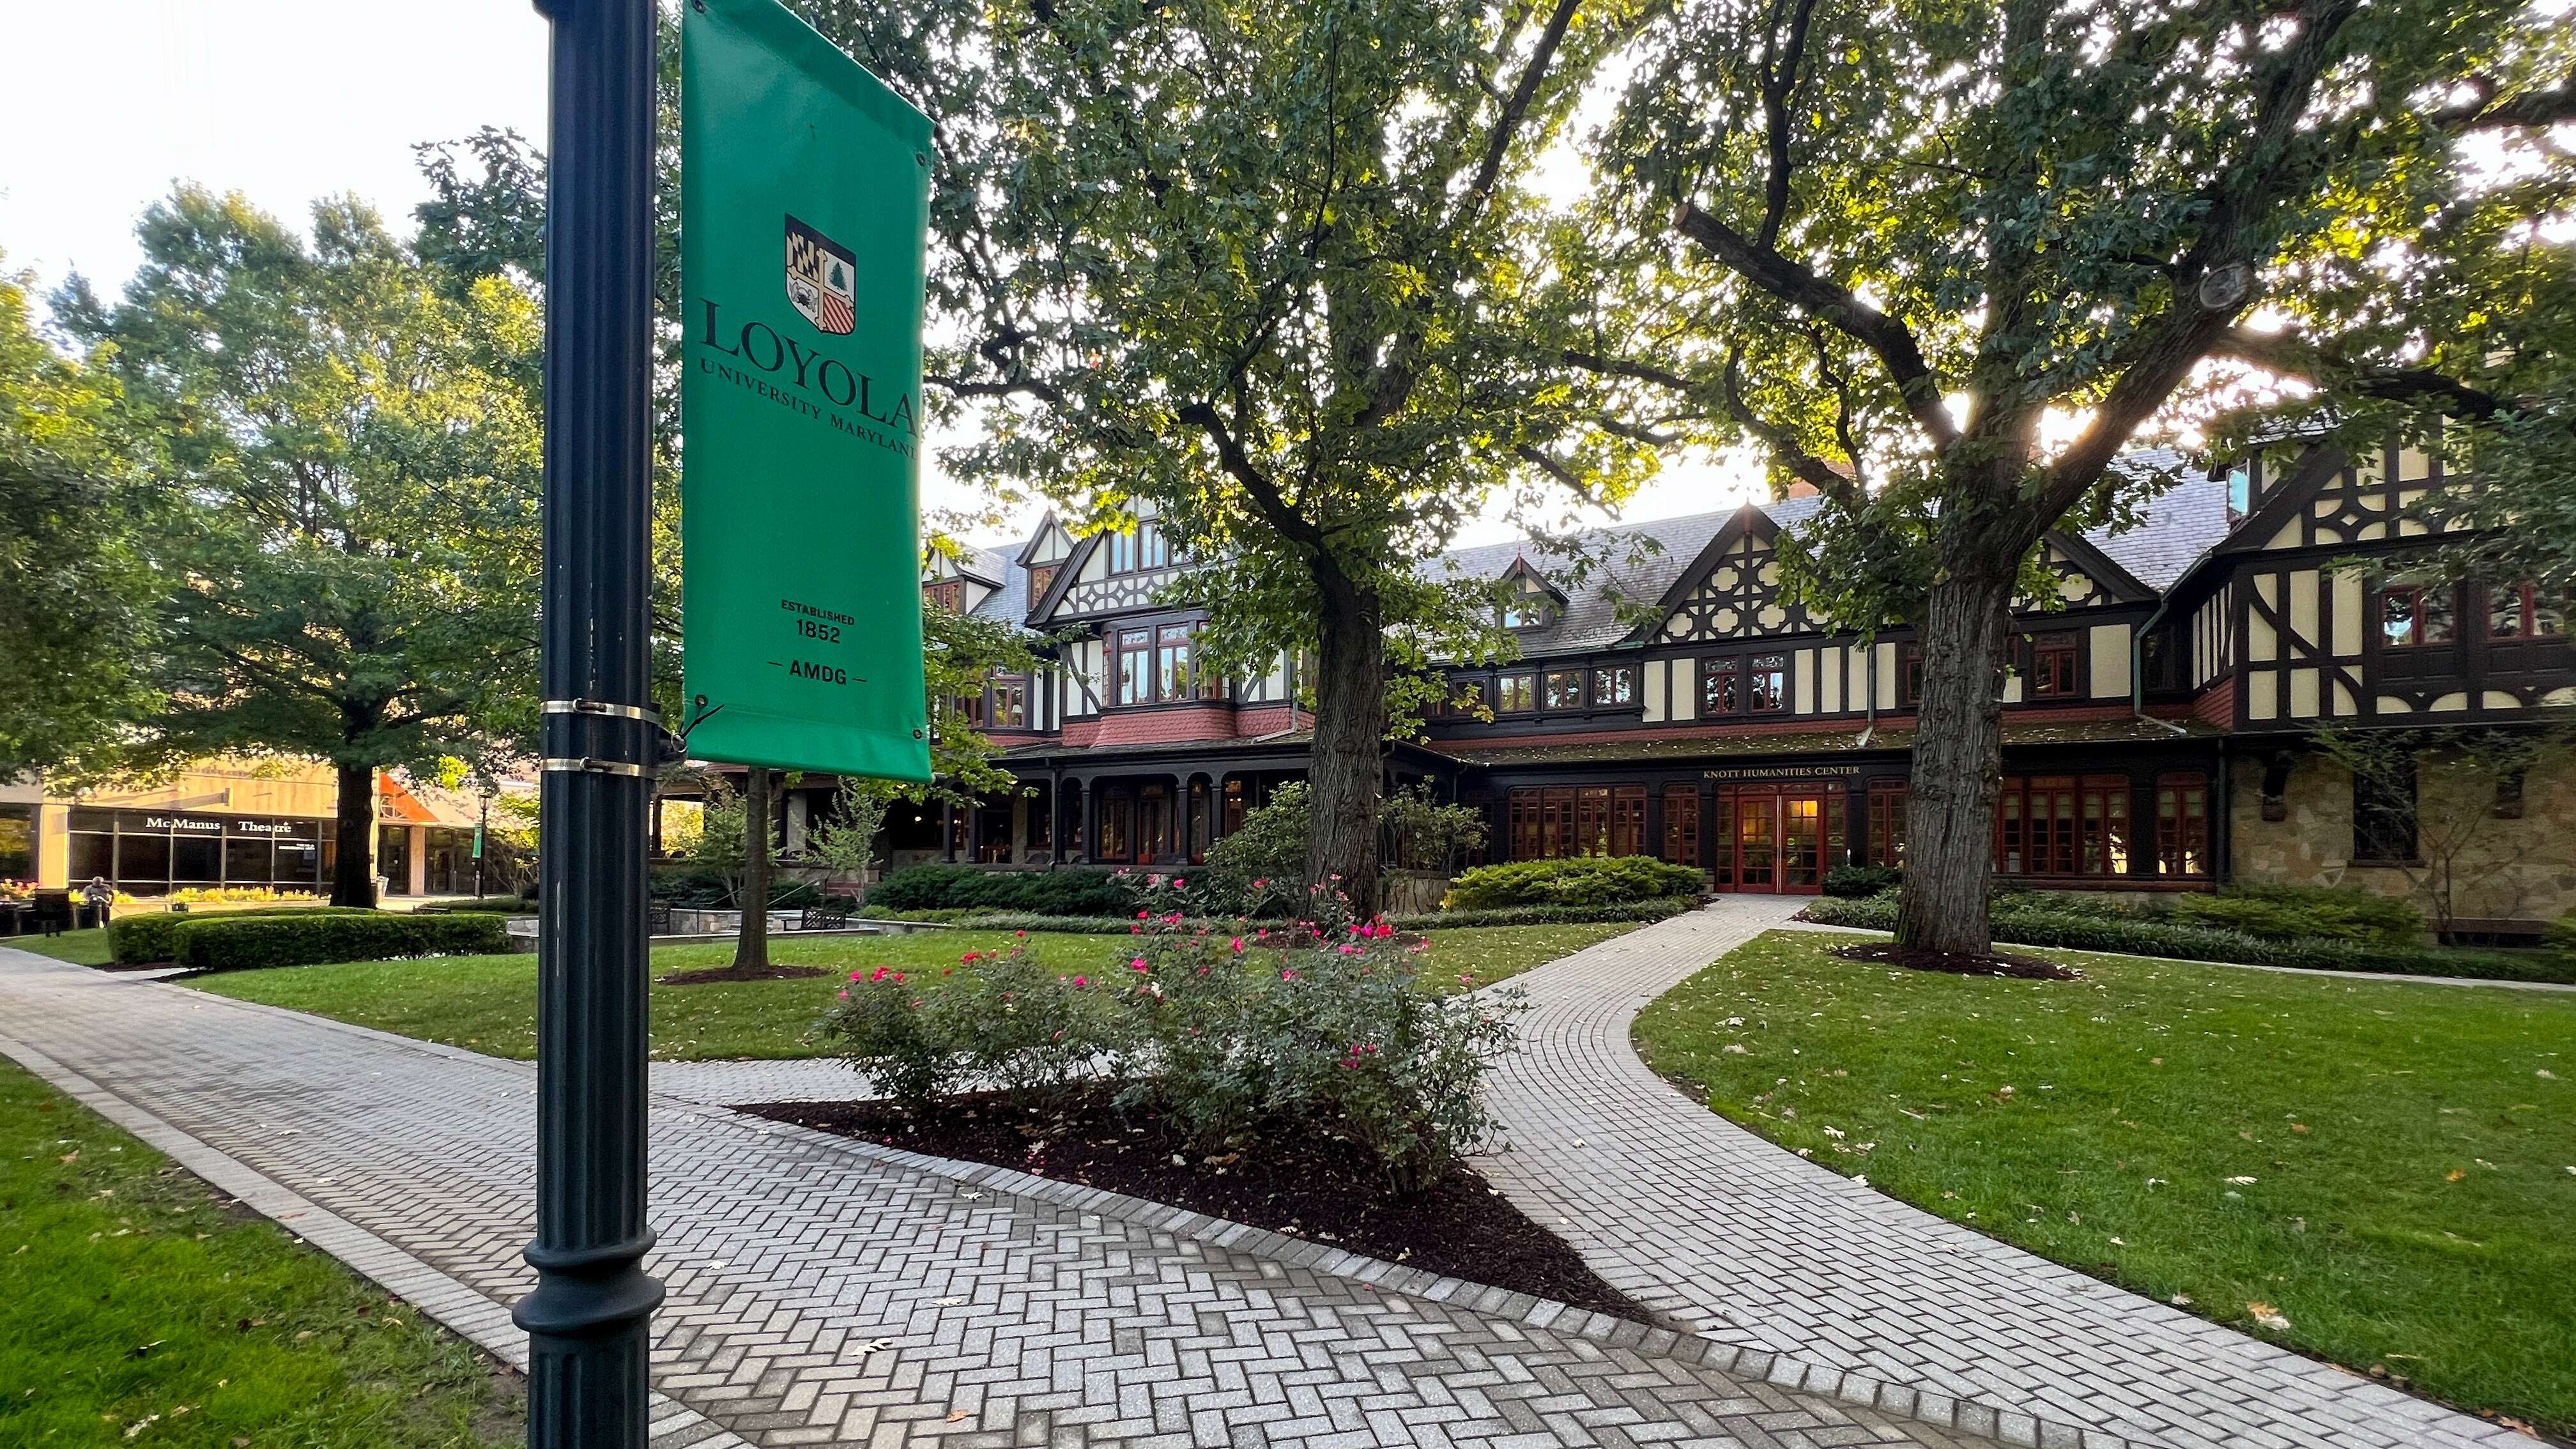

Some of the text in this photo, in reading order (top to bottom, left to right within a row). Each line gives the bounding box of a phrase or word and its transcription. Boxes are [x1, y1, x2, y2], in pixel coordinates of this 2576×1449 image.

[699, 297, 918, 439] LOYOLA
[700, 358, 918, 461] UNIVERSITY MARYLAND
[781, 599, 855, 626] ESTABLISHED
[797, 618, 841, 645] 1852
[789, 659, 847, 686] AMDG
[1703, 766, 1860, 779] KNOTT HUMANITIES CENTER
[146, 817, 292, 833] McManus Theatre
